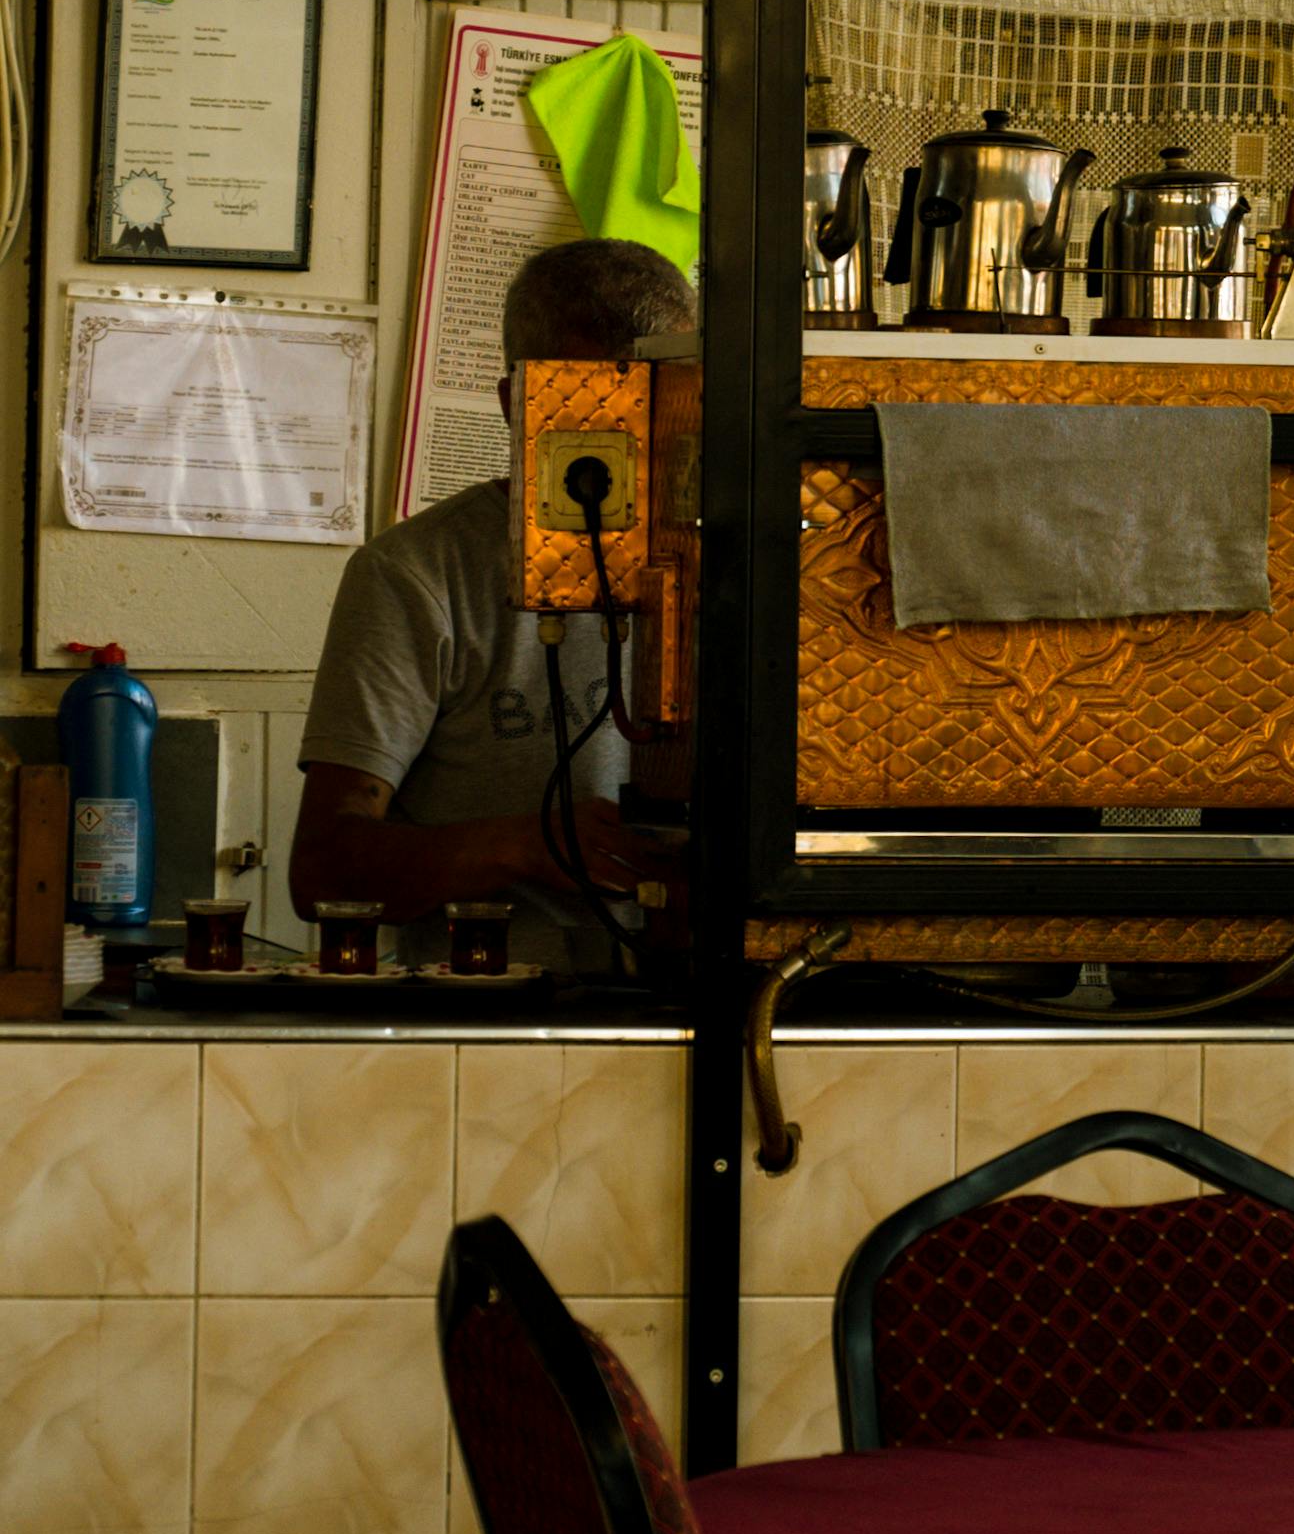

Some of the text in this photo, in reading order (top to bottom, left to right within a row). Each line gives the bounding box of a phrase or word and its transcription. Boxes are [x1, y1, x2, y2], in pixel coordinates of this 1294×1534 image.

[501, 46, 572, 65] TÜRKİYE ESNA
[462, 162, 488, 171] KAHVE
